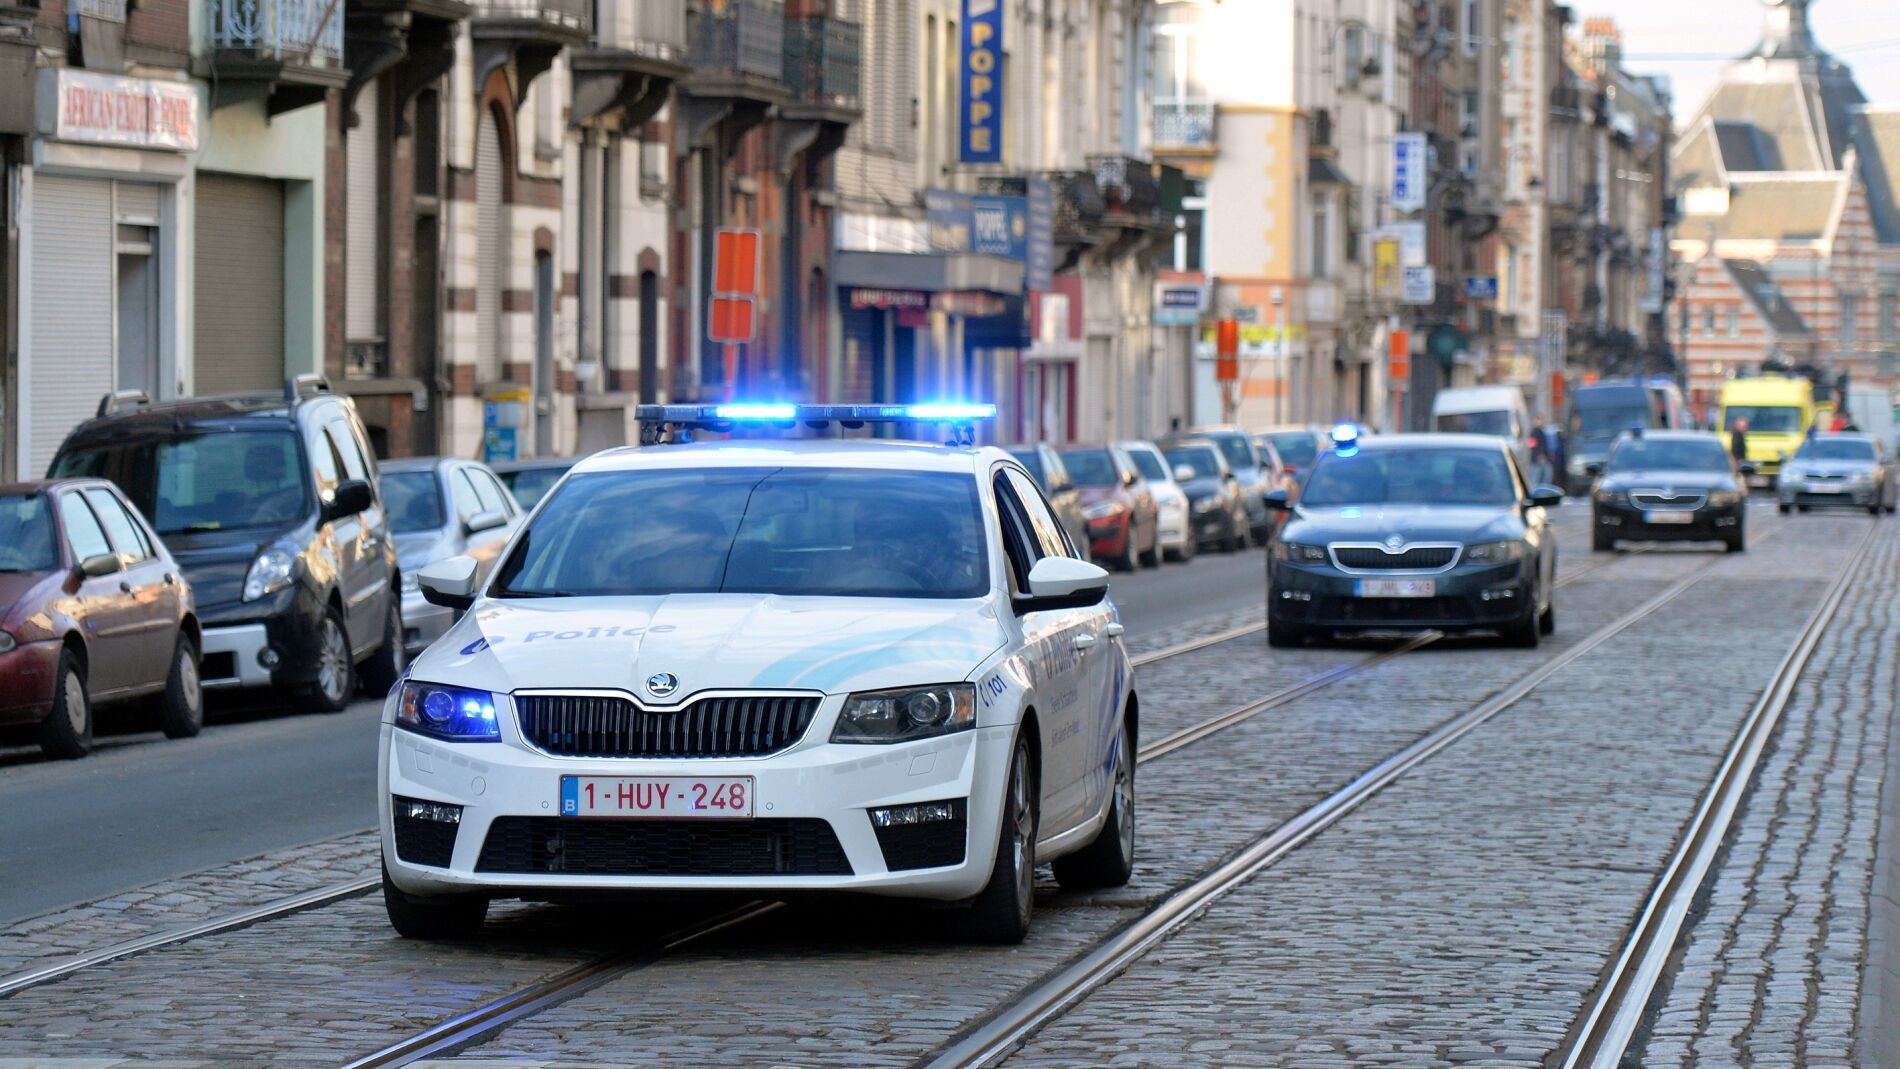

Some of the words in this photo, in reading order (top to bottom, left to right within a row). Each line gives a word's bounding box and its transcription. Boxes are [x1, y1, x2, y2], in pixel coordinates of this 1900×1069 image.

[969, 21, 994, 152] POPPE
[64, 87, 113, 129] AFRICAN
[523, 624, 677, 644] Police
[565, 799, 576, 812] B
